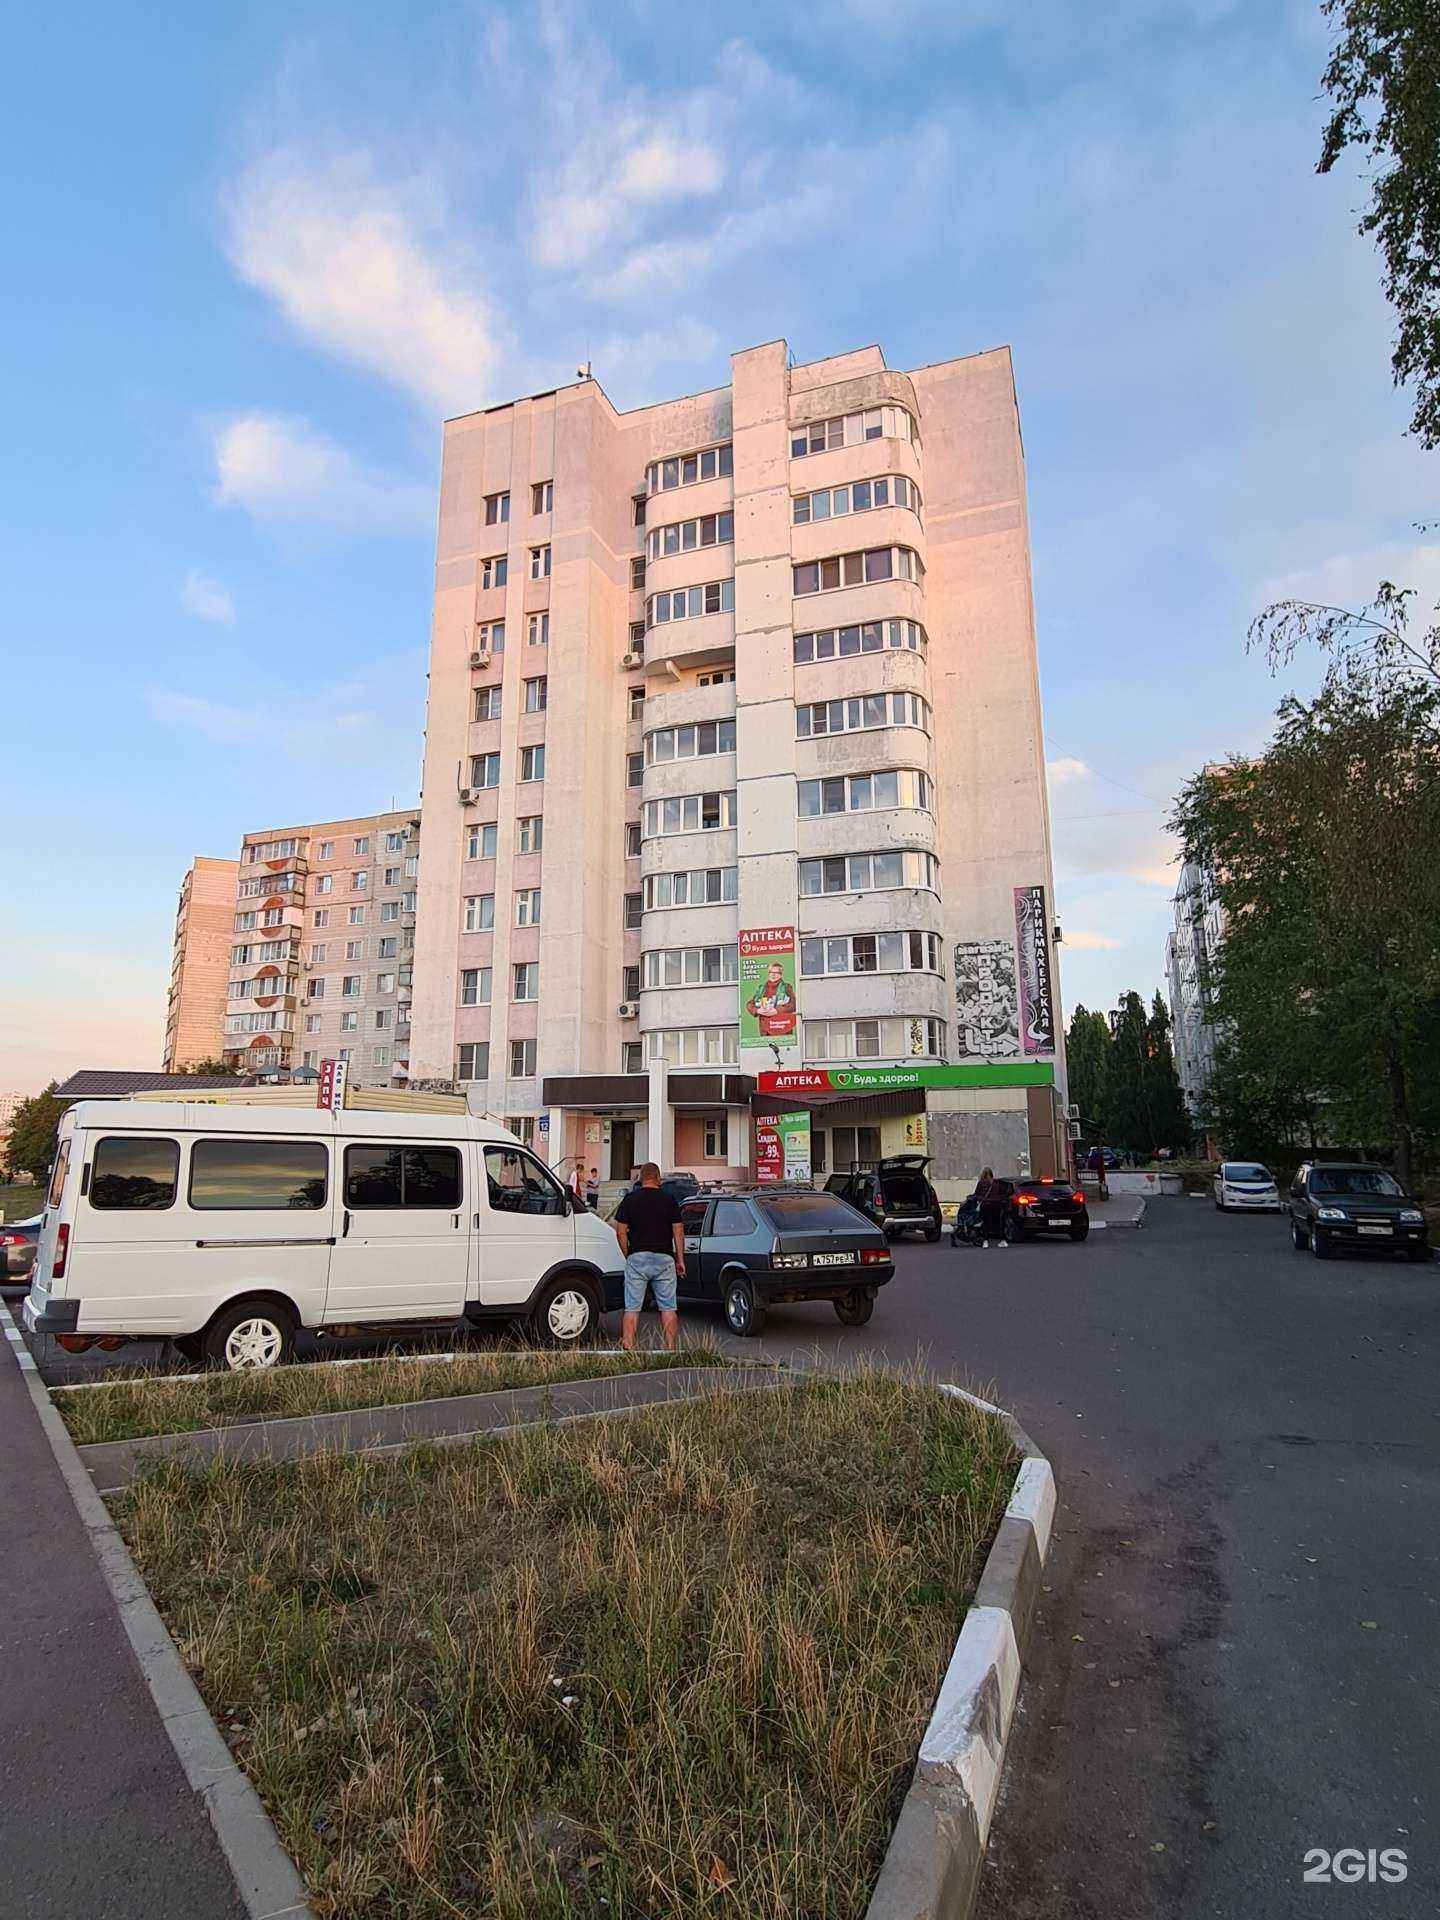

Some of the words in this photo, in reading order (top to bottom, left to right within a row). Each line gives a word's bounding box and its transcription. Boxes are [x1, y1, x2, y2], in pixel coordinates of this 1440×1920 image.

[741, 930, 793, 943] АПТЕКА
[1032, 889, 1049, 1027] ПАРИКМАХЕРСКАЯ
[977, 955, 1000, 1055] ПРОДУКТЫ
[775, 1075, 822, 1086] АПТЕКА
[853, 1074, 878, 1084] Будь
[879, 1073, 919, 1083] здоров!
